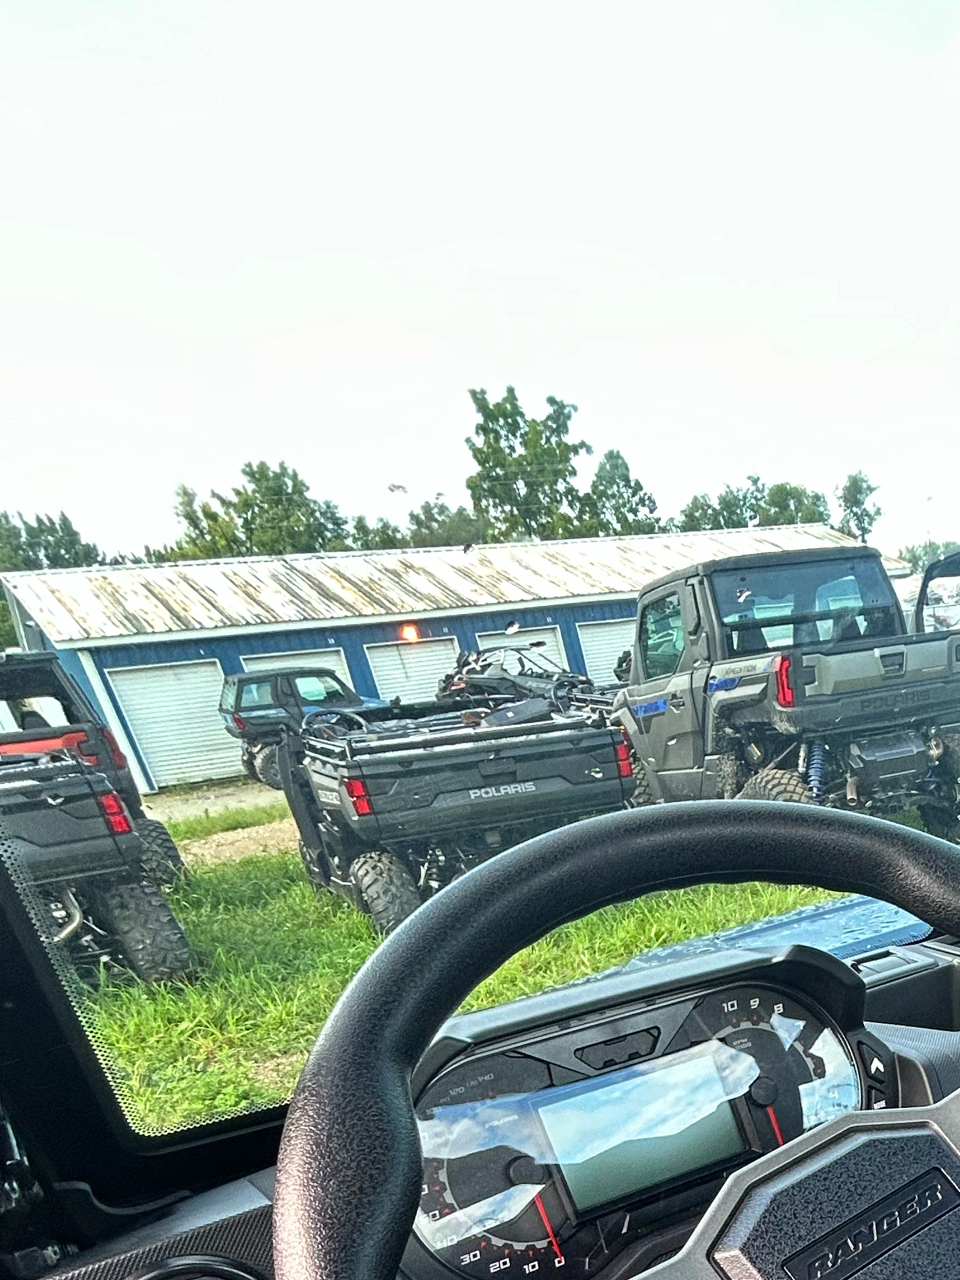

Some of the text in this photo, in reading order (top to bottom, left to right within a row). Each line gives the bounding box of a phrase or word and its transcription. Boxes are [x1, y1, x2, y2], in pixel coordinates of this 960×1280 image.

[468, 781, 536, 799] POLARIS
[722, 1000, 738, 1013] 10
[750, 998, 759, 1010] 9
[774, 1003, 784, 1015] 8
[449, 1086, 465, 1096] 120
[460, 1250, 481, 1266] 30
[554, 1256, 565, 1268] 0
[489, 1257, 511, 1273] 20
[523, 1260, 539, 1274] 10
